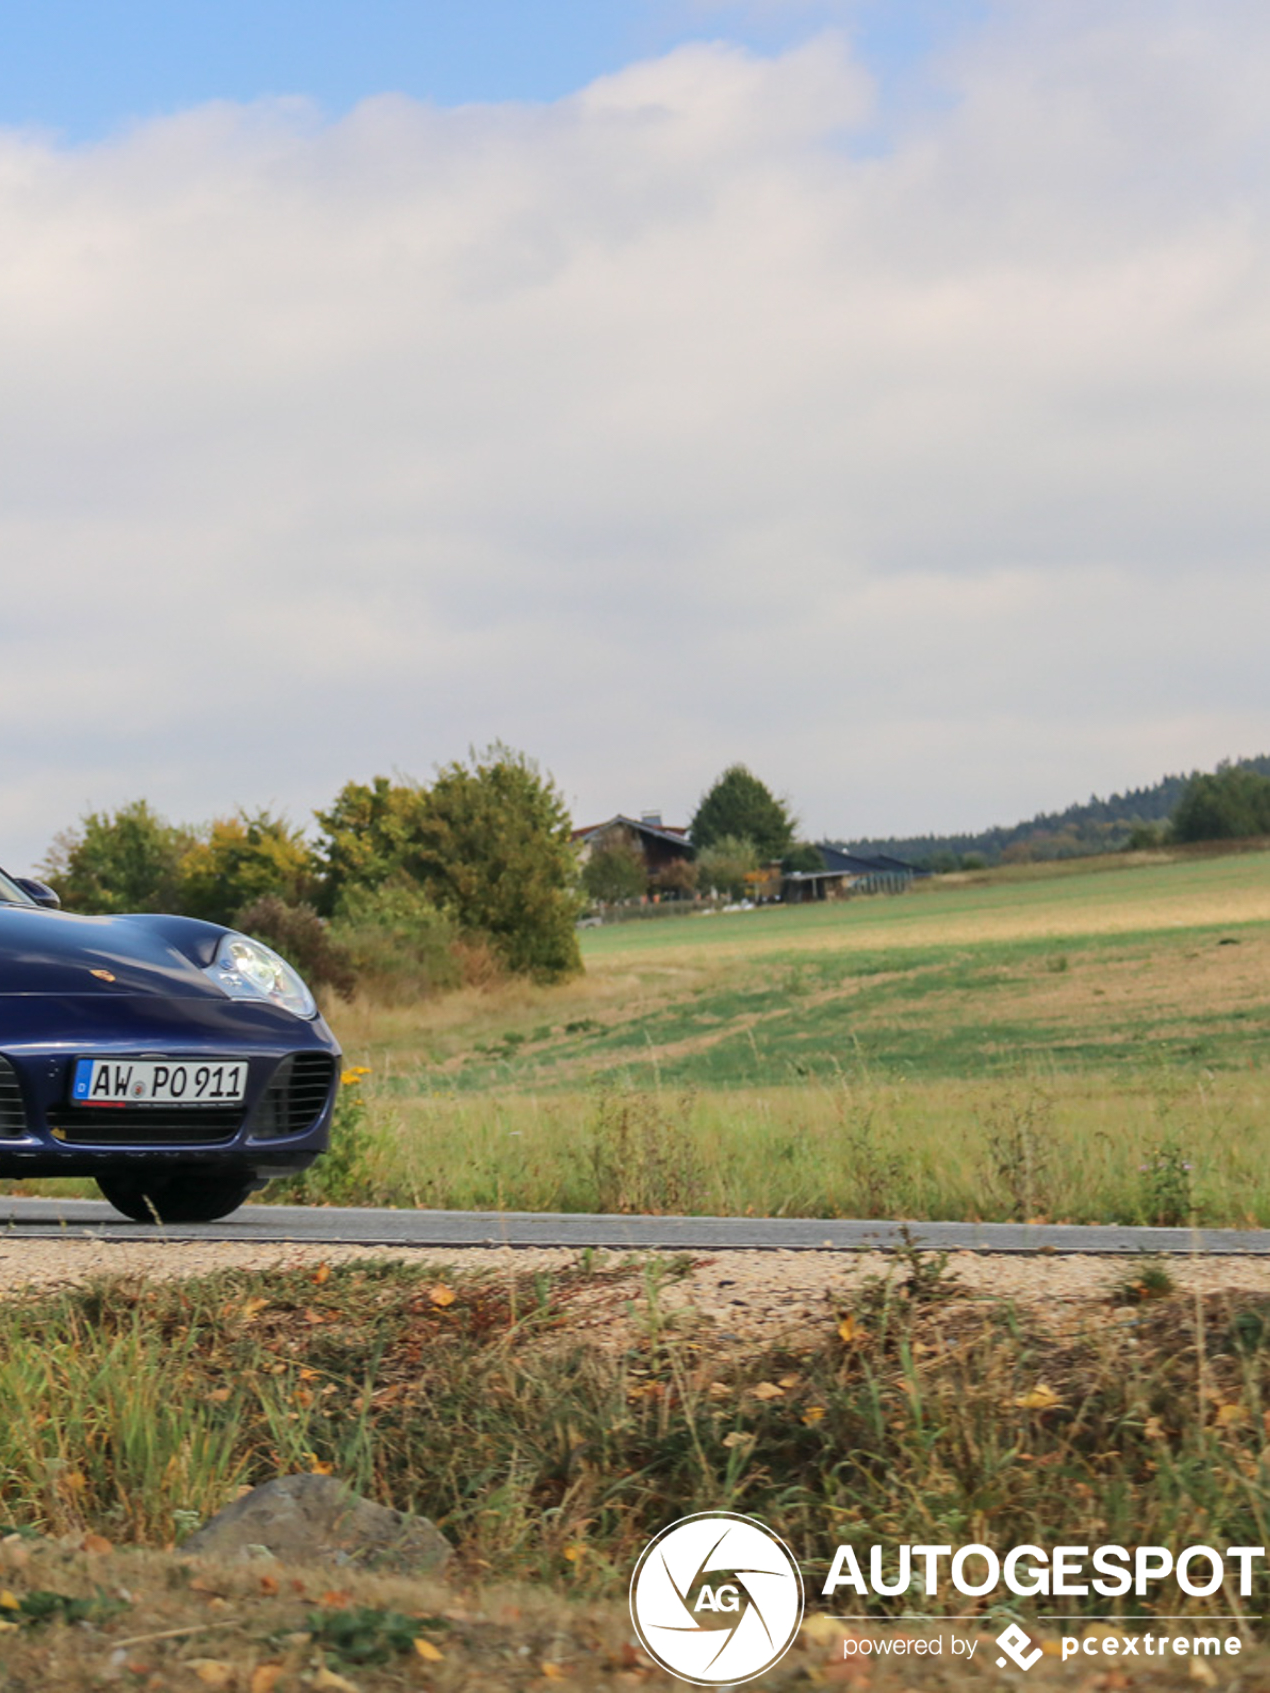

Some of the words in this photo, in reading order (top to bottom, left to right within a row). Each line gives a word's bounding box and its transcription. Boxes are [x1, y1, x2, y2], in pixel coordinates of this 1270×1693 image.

[92, 1065, 133, 1096] AW
[151, 1066, 187, 1098] PO
[194, 1067, 241, 1098] 911
